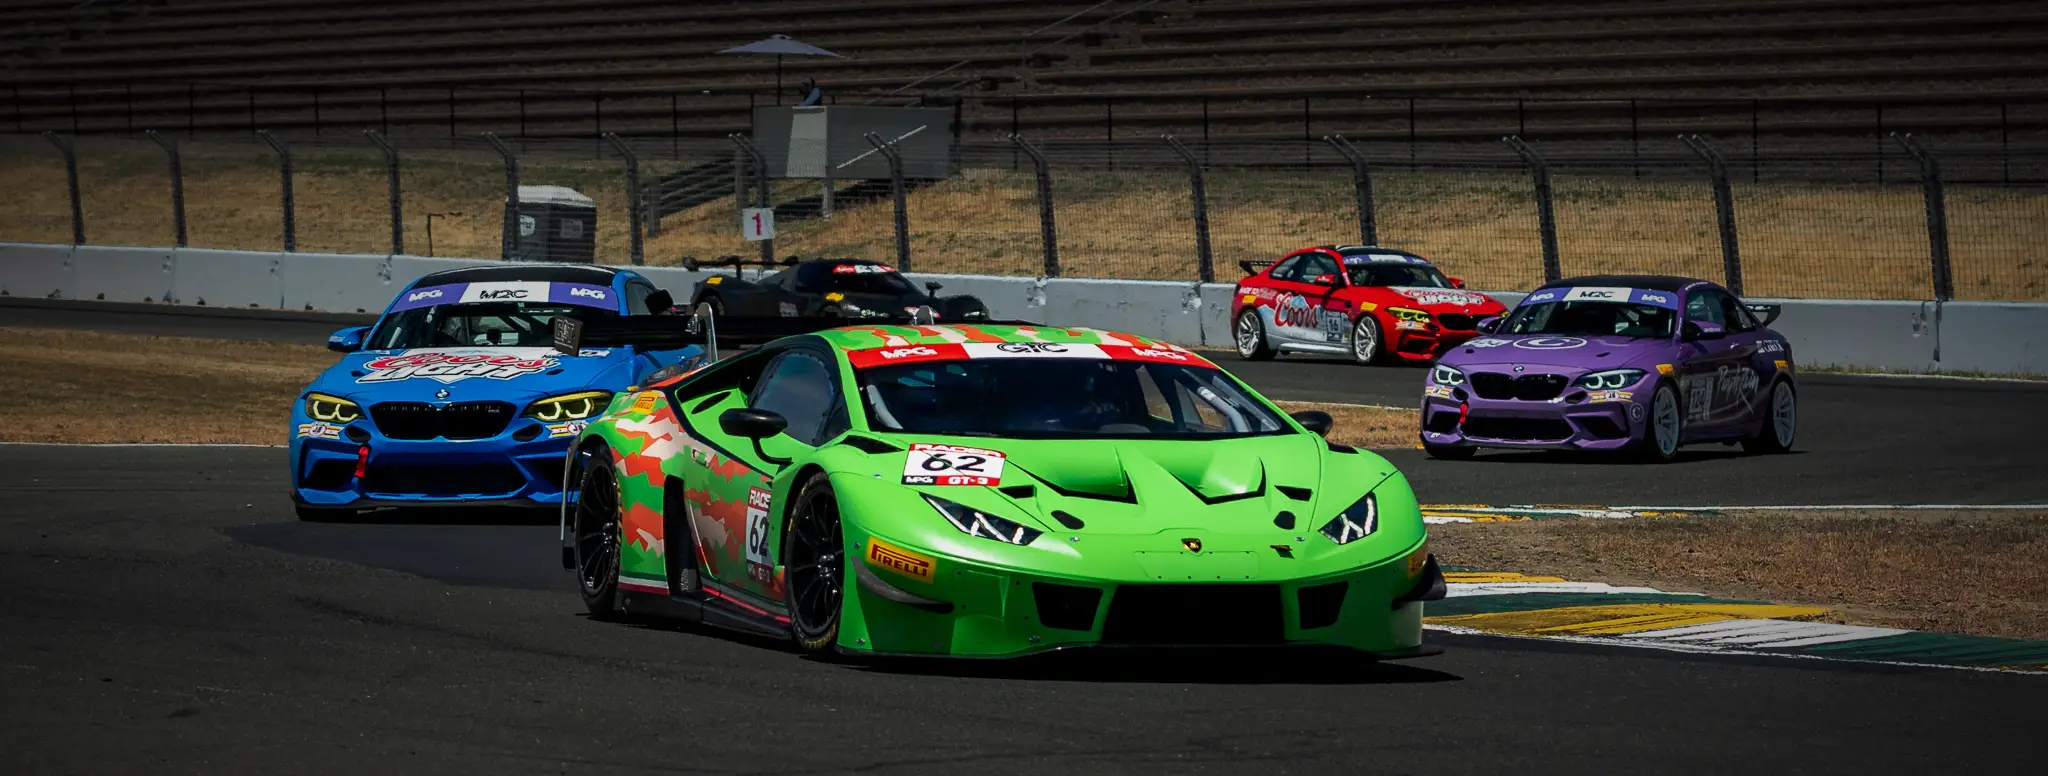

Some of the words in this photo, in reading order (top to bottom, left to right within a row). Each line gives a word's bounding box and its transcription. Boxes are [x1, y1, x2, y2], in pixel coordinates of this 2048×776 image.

[752, 213, 761, 235] 1
[480, 289, 528, 299] M2C
[1275, 292, 1320, 328] Coors
[997, 342, 1069, 354] GTC
[921, 453, 987, 472] 62
[749, 489, 771, 509] RACE
[750, 514, 769, 557] 62
[871, 544, 930, 577] PIRELLI
